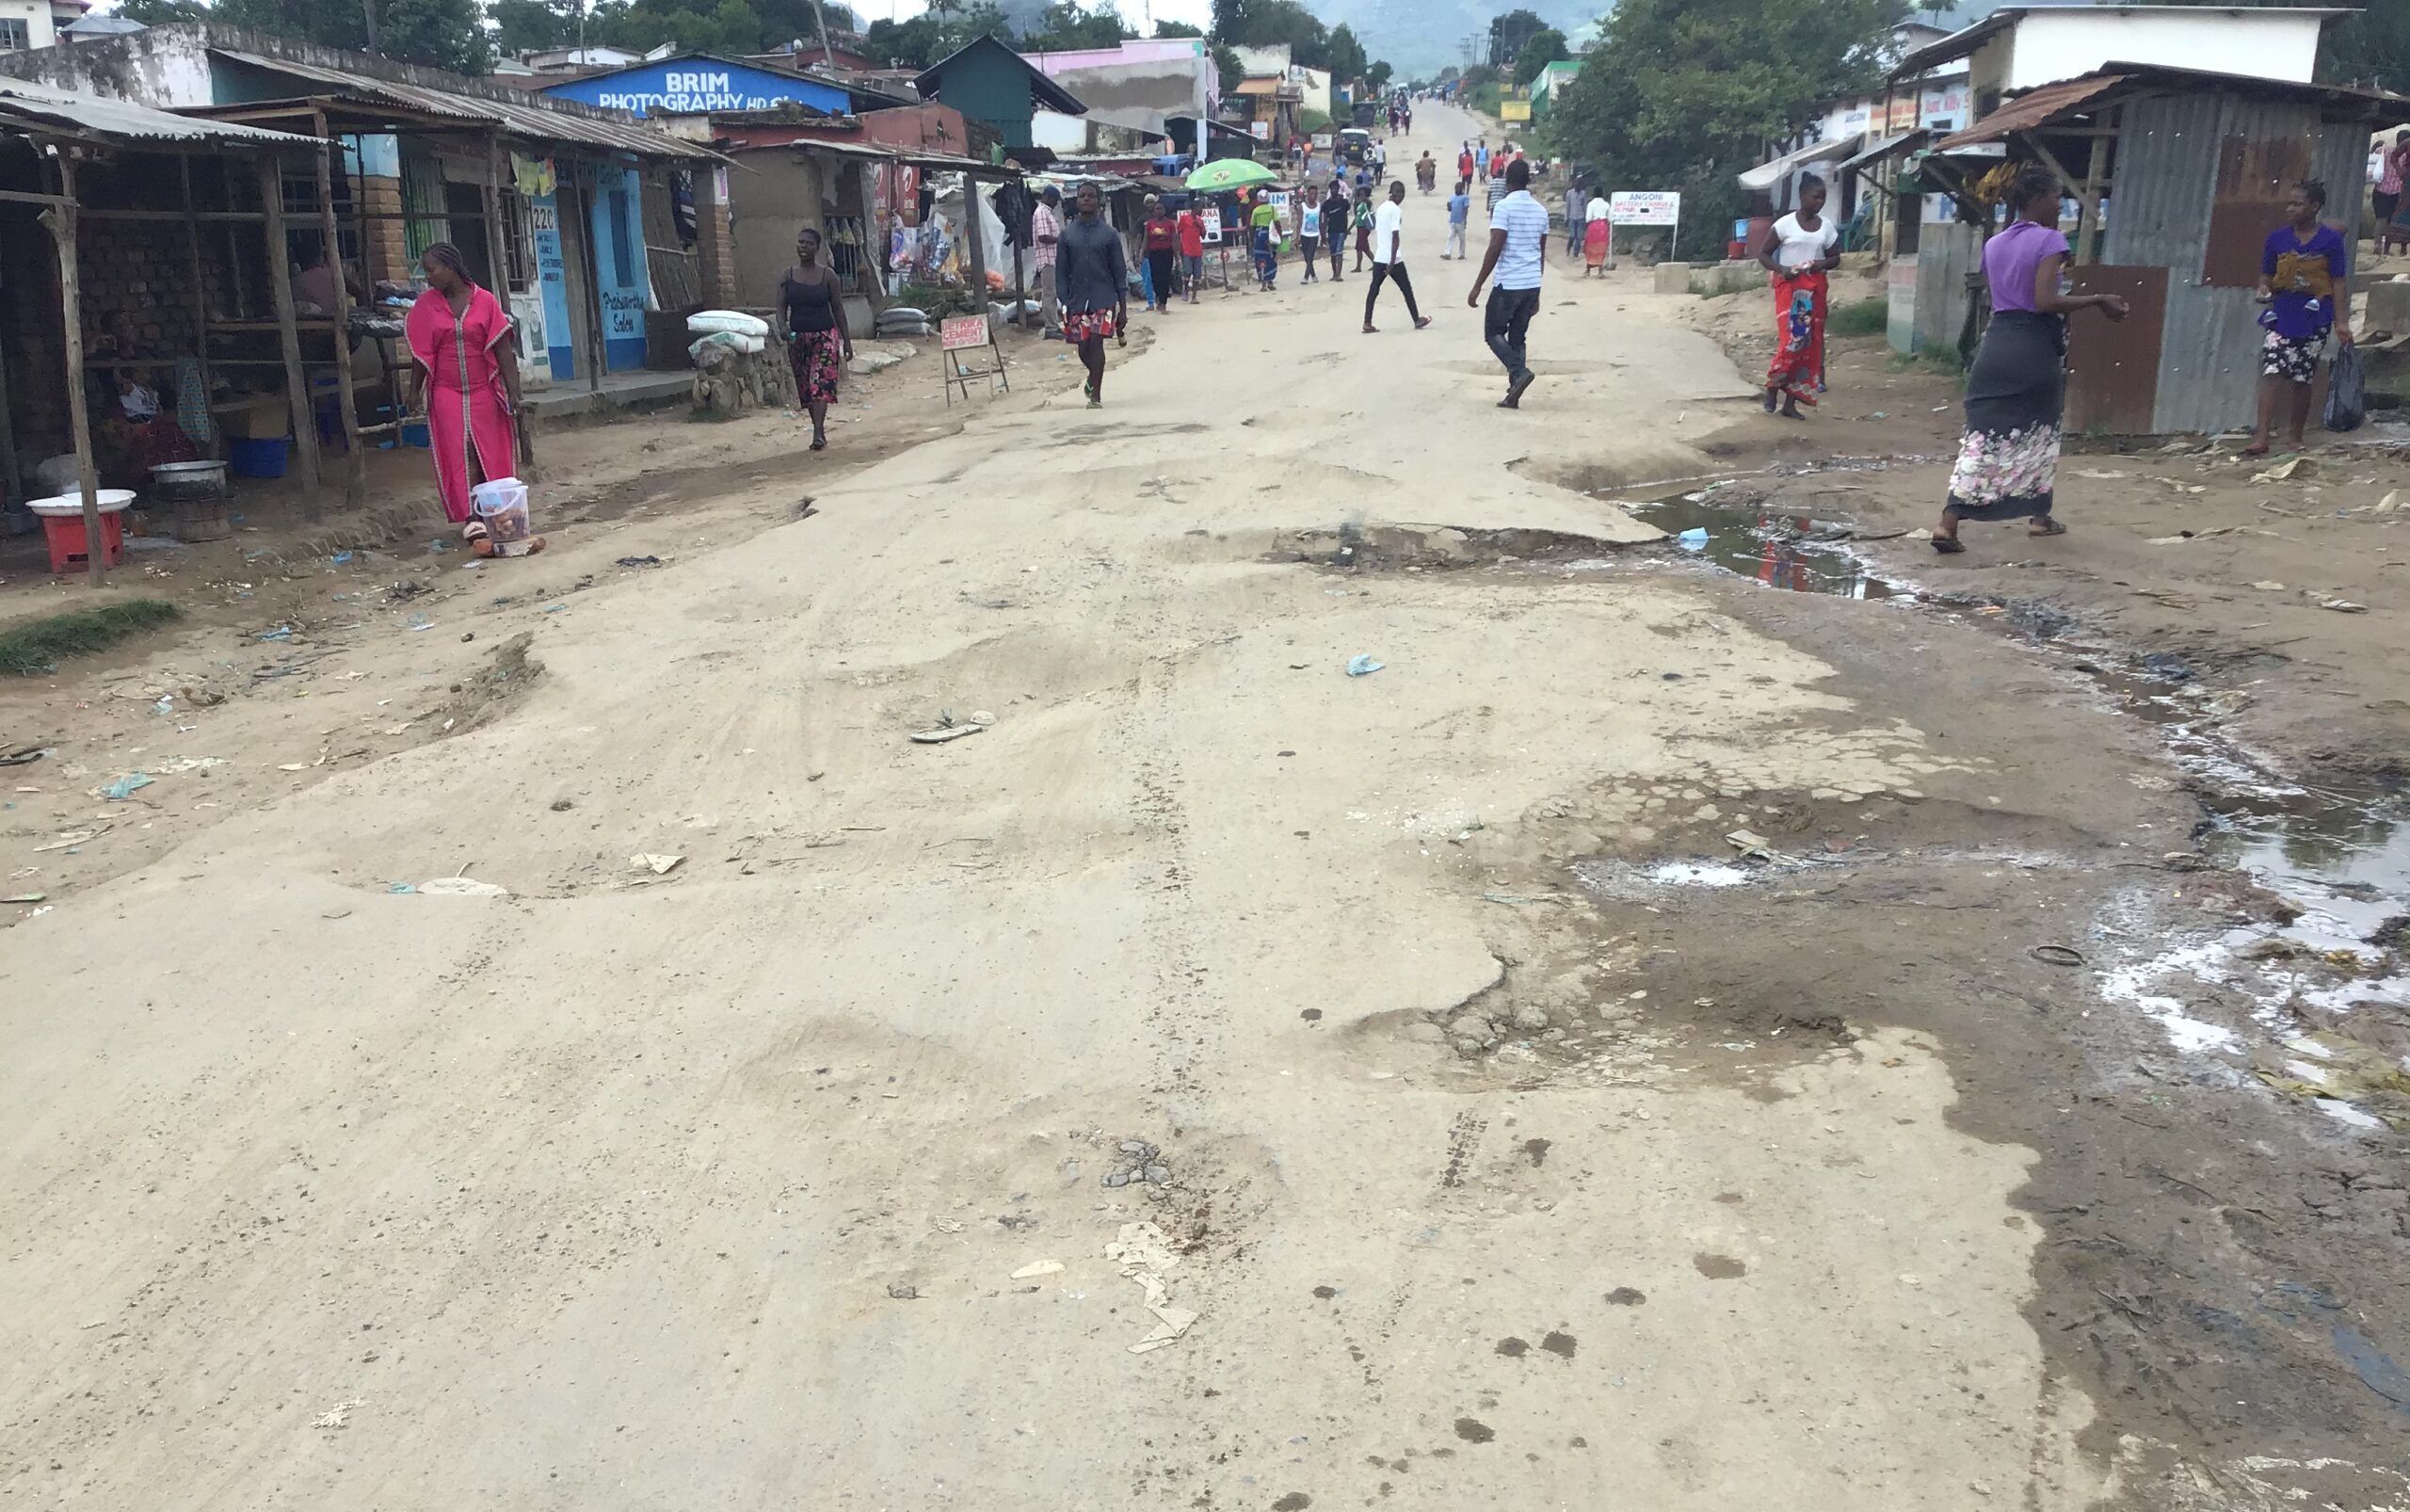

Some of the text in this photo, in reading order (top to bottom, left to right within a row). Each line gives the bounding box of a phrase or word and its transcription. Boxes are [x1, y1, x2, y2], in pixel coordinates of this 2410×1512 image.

[666, 72, 729, 92] BRIM
[599, 93, 744, 112] PHOTOGRAPHY
[613, 313, 635, 332] Salon
[943, 328, 983, 340] CEMENT
